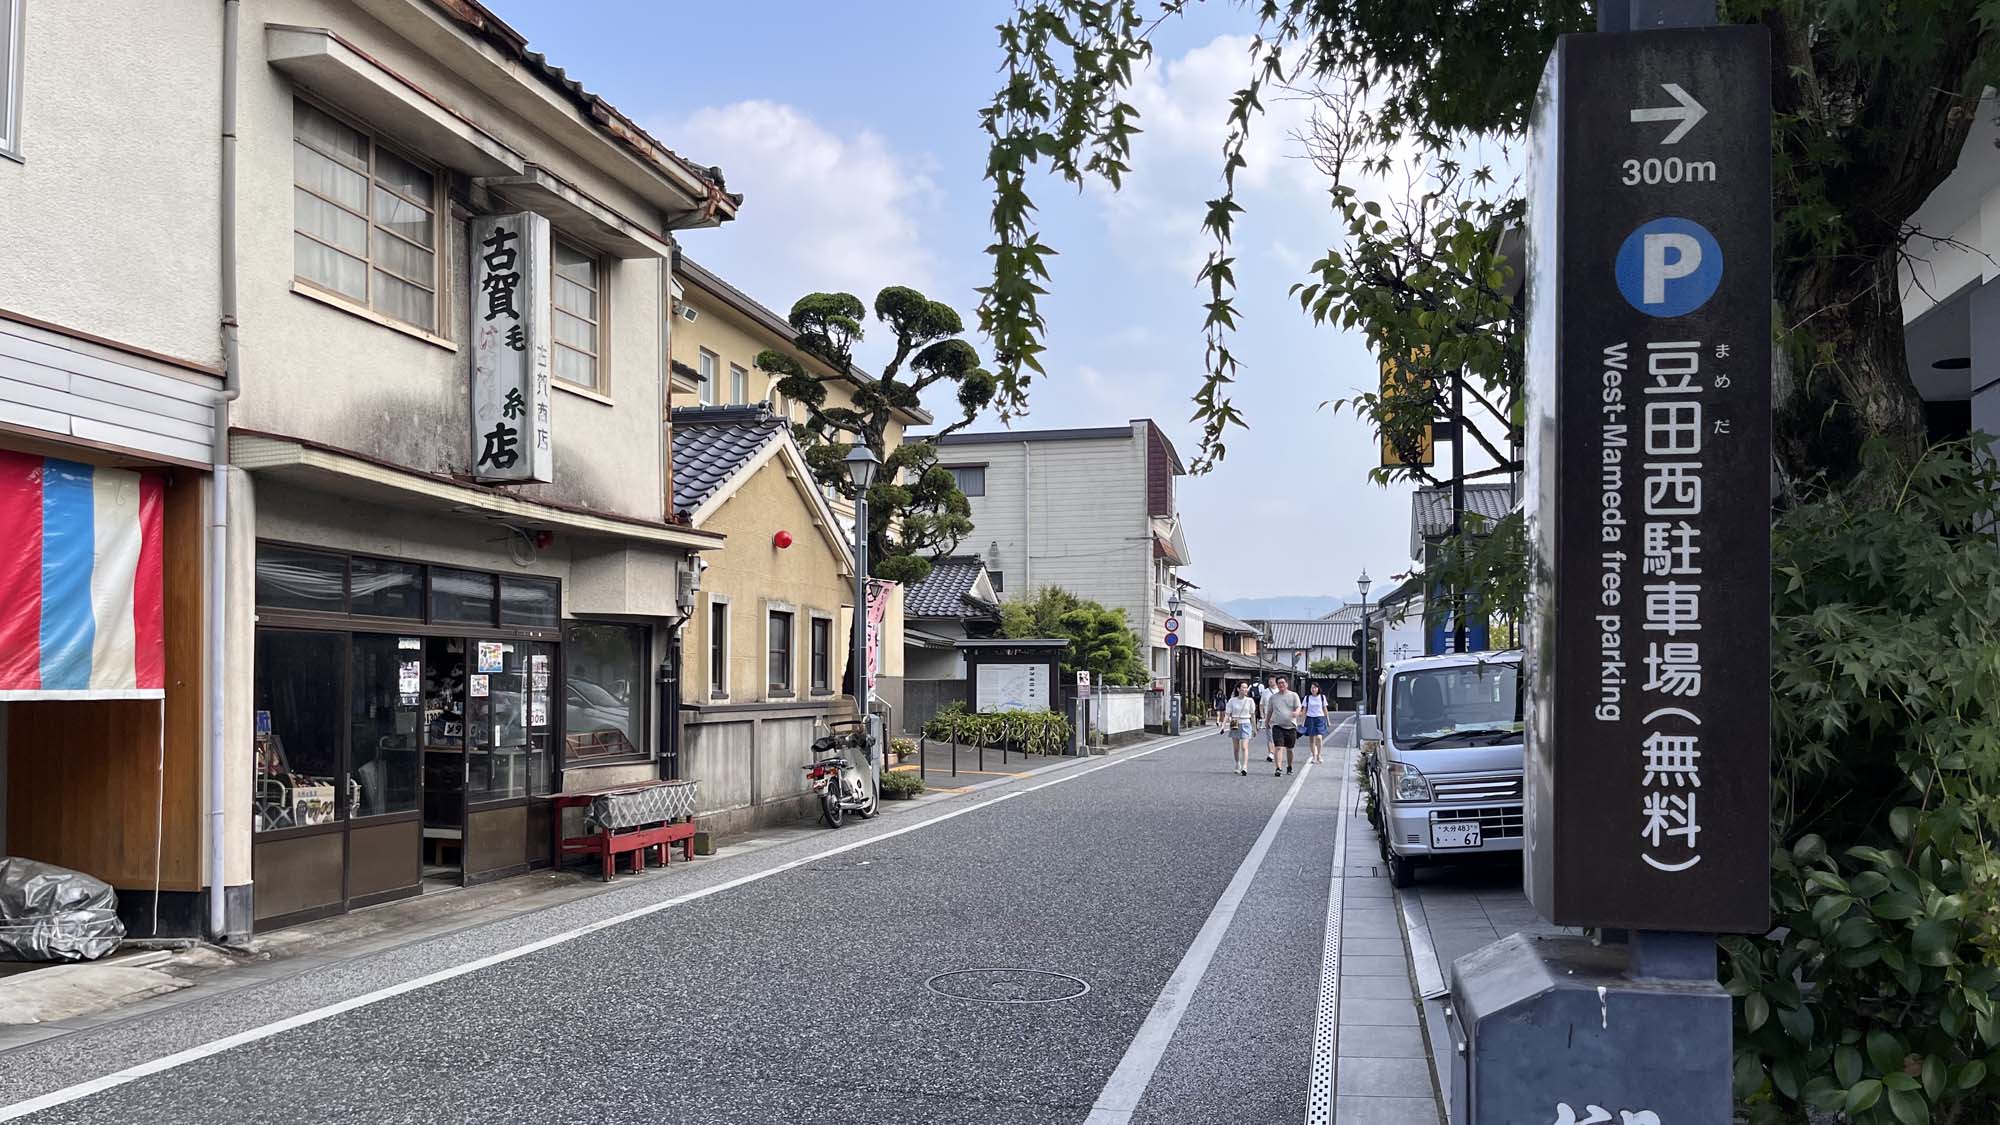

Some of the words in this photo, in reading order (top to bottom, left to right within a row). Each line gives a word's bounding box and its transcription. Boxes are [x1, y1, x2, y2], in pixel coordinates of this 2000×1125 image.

[1622, 157, 1716, 186] 300m
[1643, 233, 1702, 304] P
[478, 226, 526, 470] 古賀毛糸店
[1602, 342, 1628, 543] West-Mameda
[1601, 550, 1627, 607] free
[1595, 614, 1626, 721] parking
